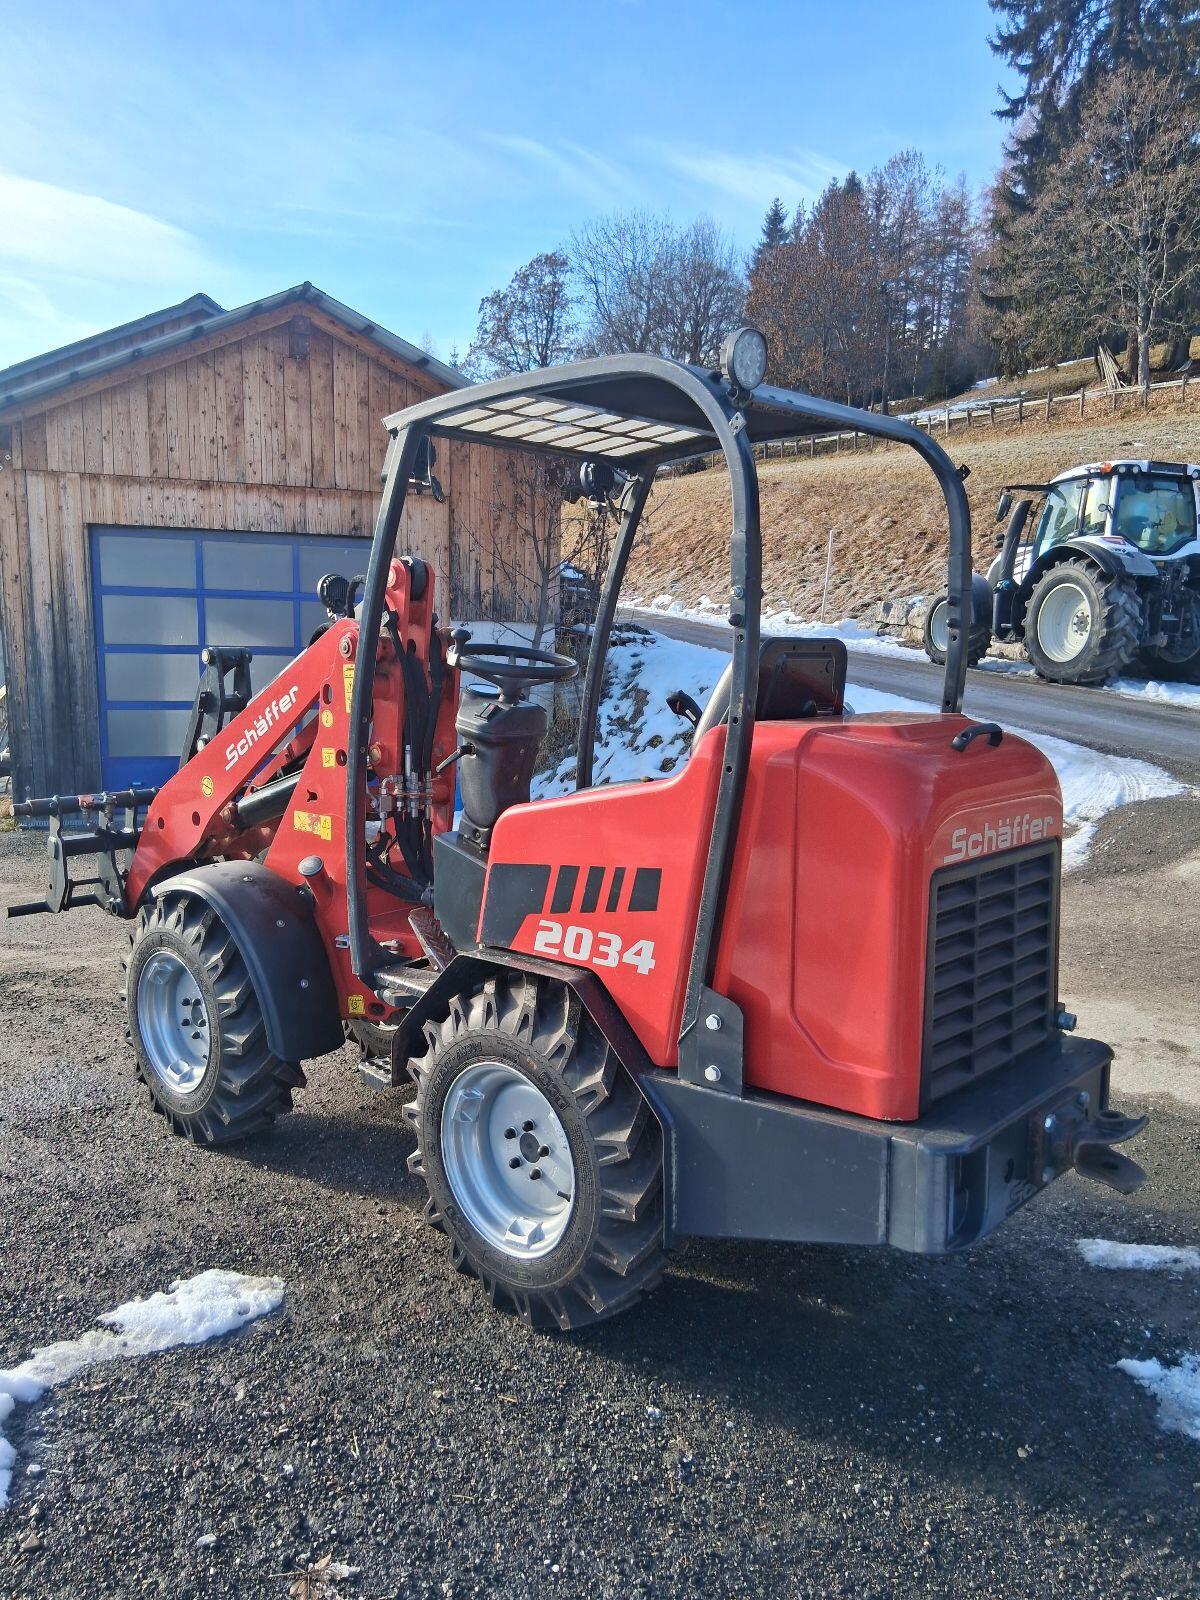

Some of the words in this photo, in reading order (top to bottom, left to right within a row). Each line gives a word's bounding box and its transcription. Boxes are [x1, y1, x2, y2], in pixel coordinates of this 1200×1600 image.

[224, 686, 299, 772] Schäffer
[943, 813, 1054, 864] Schäffer
[534, 919, 656, 975] 2034
